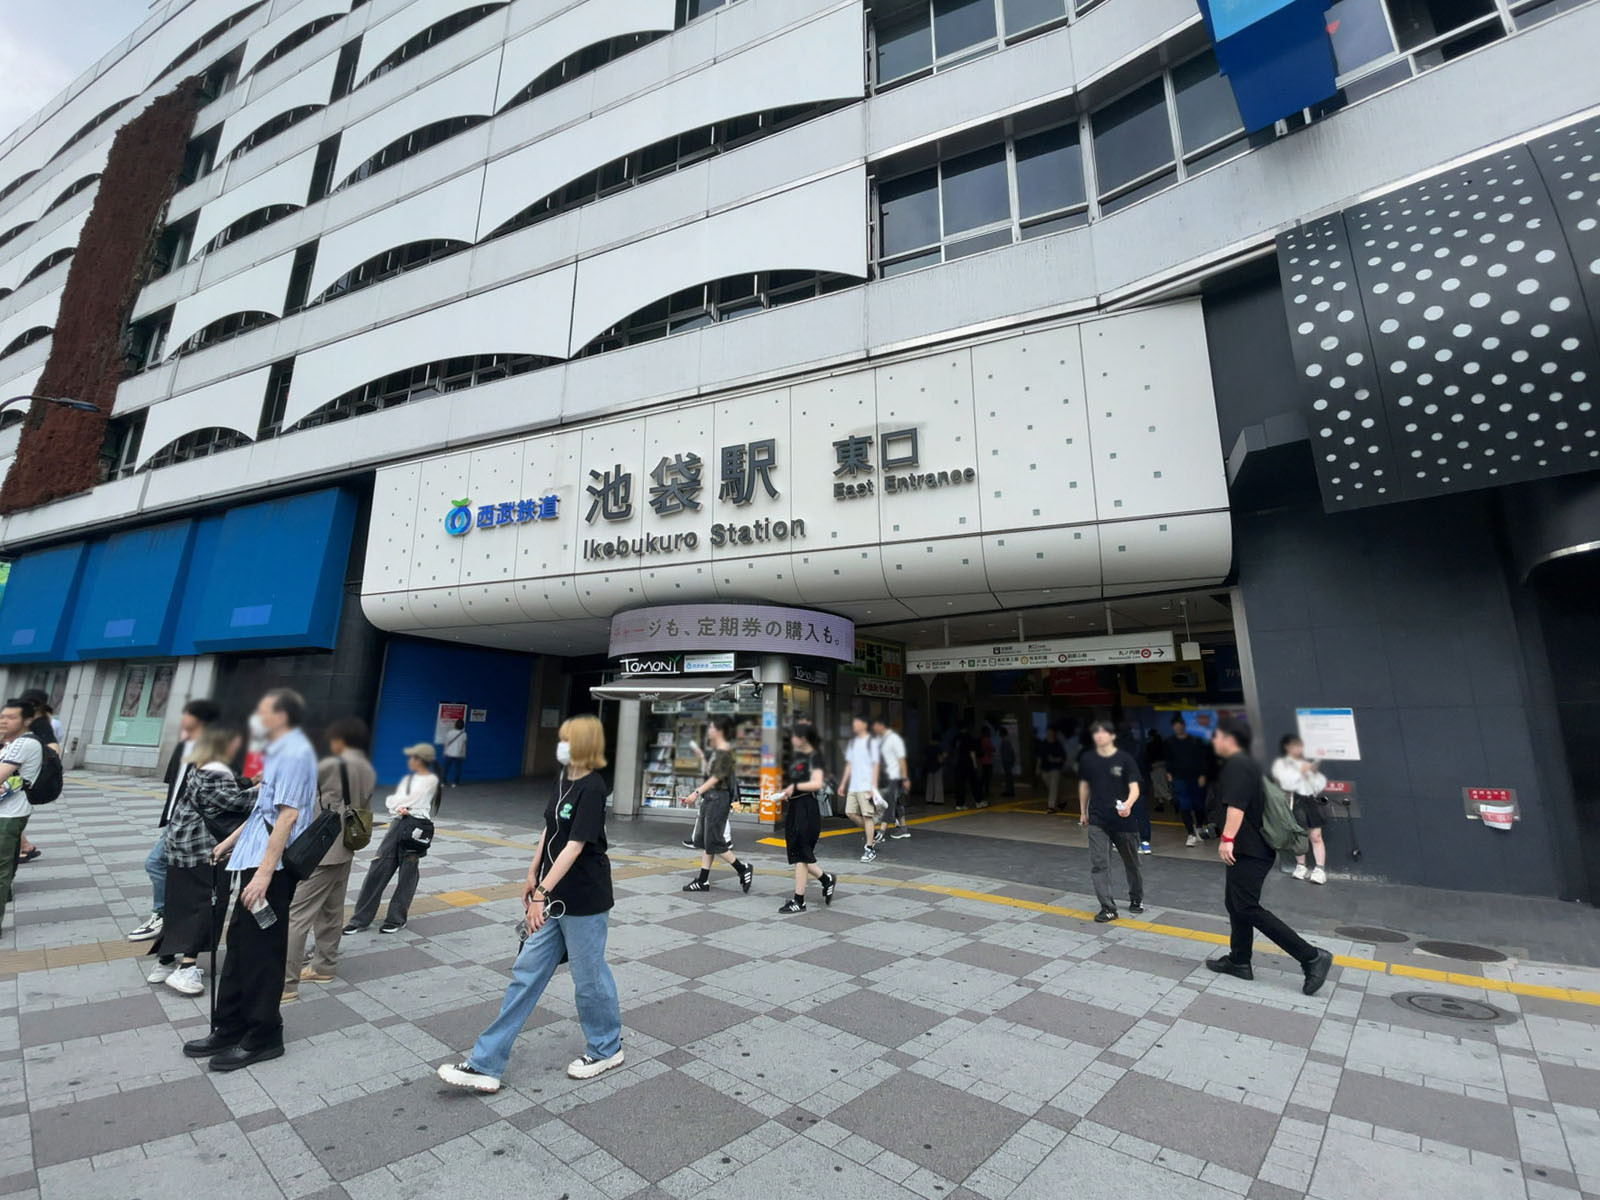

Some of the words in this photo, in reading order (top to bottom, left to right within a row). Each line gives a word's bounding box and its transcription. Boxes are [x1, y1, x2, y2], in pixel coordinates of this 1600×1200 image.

[832, 428, 920, 476] 東口
[585, 438, 780, 524] 池袋駅
[833, 478, 874, 499] East
[885, 466, 976, 494] Entrance
[476, 494, 560, 529] 西武鉄道
[583, 531, 698, 561] Ikebukuro
[710, 517, 806, 547] Station
